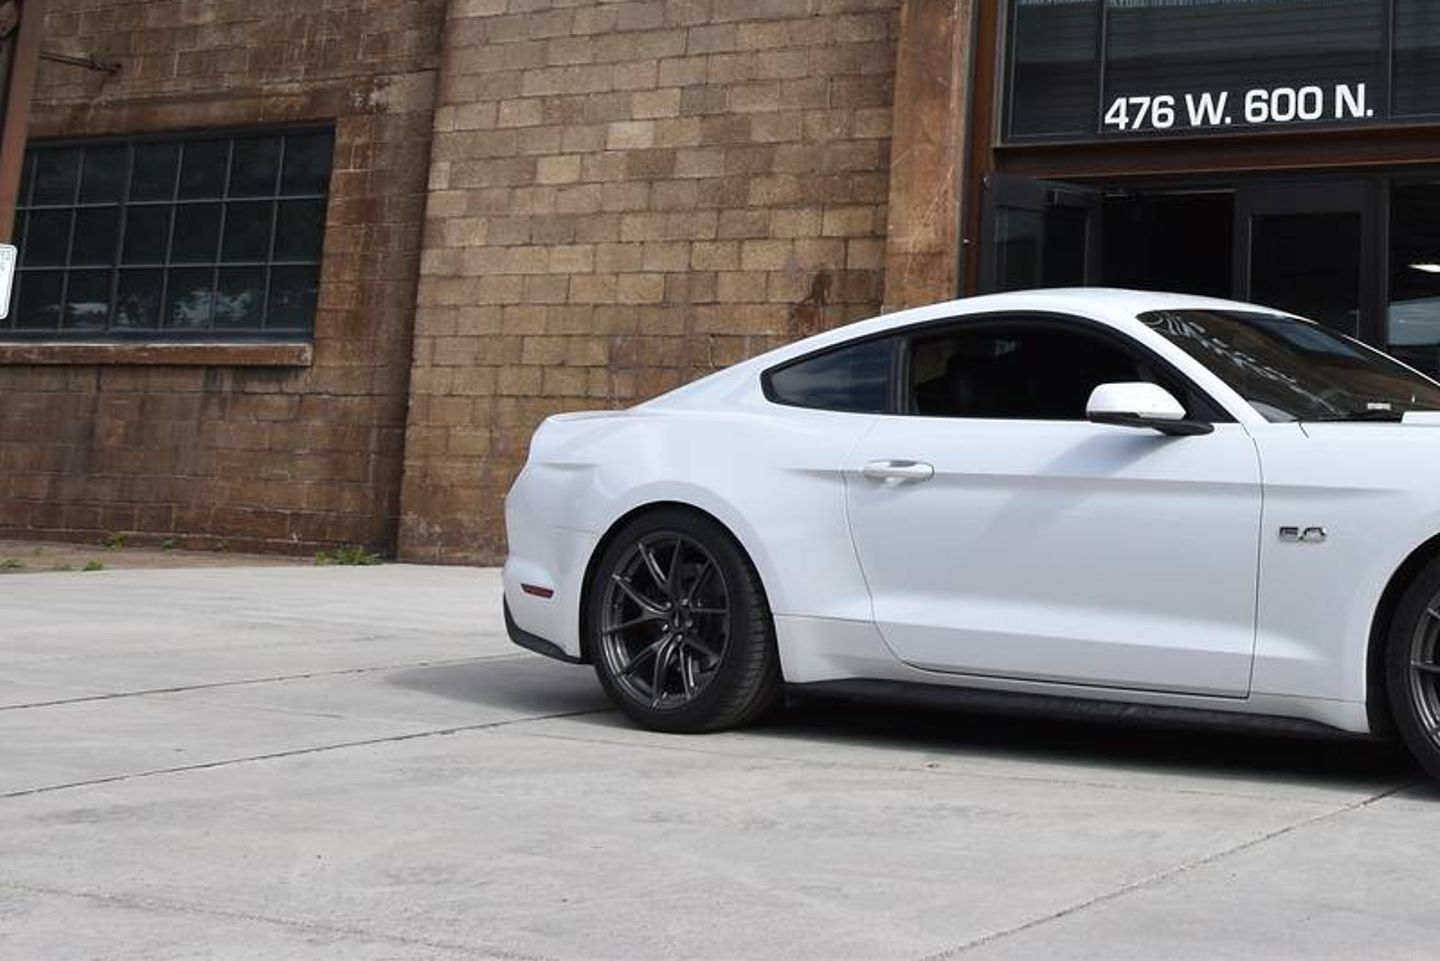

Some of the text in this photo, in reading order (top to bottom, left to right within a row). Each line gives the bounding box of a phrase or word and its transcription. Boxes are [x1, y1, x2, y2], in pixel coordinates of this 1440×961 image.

[1103, 82, 1374, 130] 476 W. 600 N.
[1279, 526, 1326, 543] 5.0
